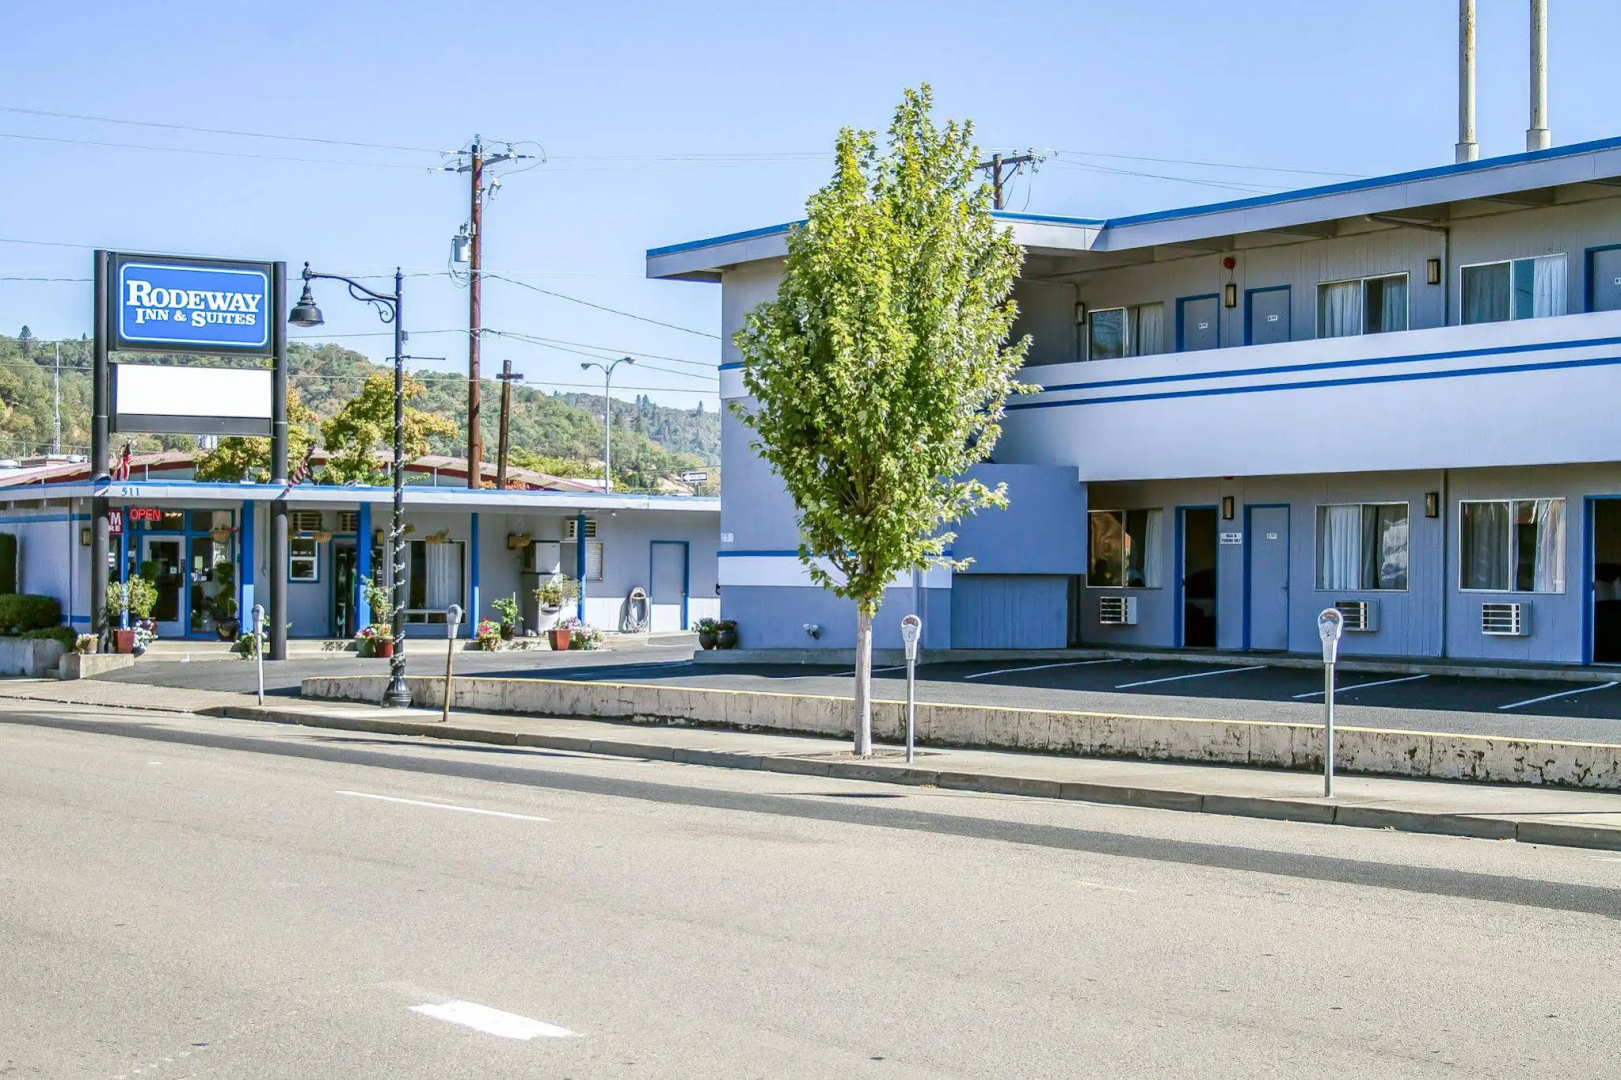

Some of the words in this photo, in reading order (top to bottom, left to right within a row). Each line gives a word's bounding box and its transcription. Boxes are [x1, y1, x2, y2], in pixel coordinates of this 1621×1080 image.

[126, 280, 262, 312] RODEWAY
[135, 308, 169, 324] INN
[173, 310, 188, 322] &
[191, 311, 256, 327] SUITES
[121, 487, 141, 496] 511
[130, 508, 162, 520] OPEN
